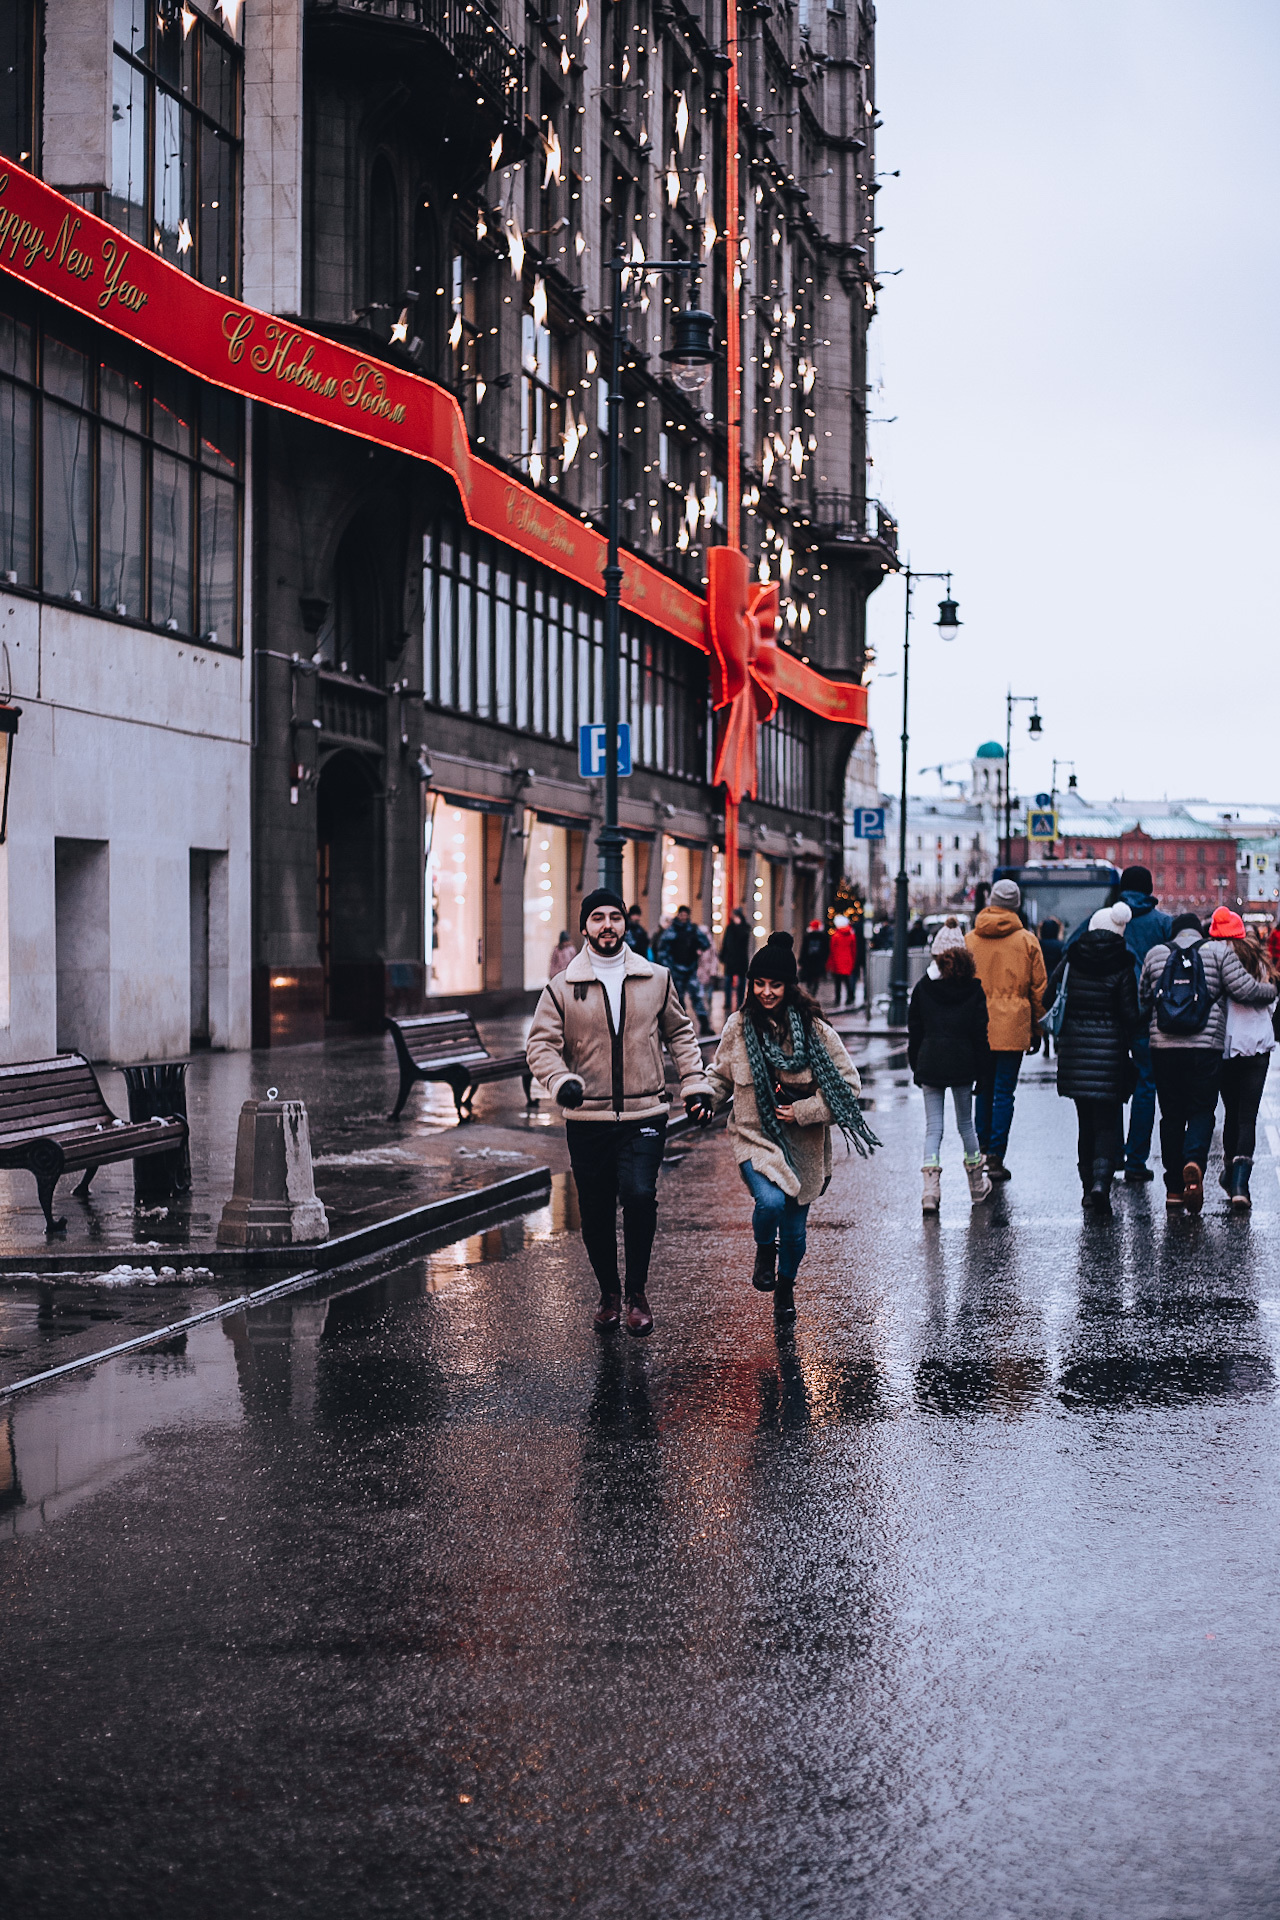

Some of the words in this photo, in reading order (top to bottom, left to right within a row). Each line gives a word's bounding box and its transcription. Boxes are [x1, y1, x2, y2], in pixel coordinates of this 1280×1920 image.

[0, 173, 45, 269] appy
[45, 213, 94, 280] New
[98, 238, 148, 312] Year
[222, 311, 255, 364] С
[251, 324, 338, 399] Новым
[340, 361, 407, 424] Годом
[861, 810, 879, 837] P
